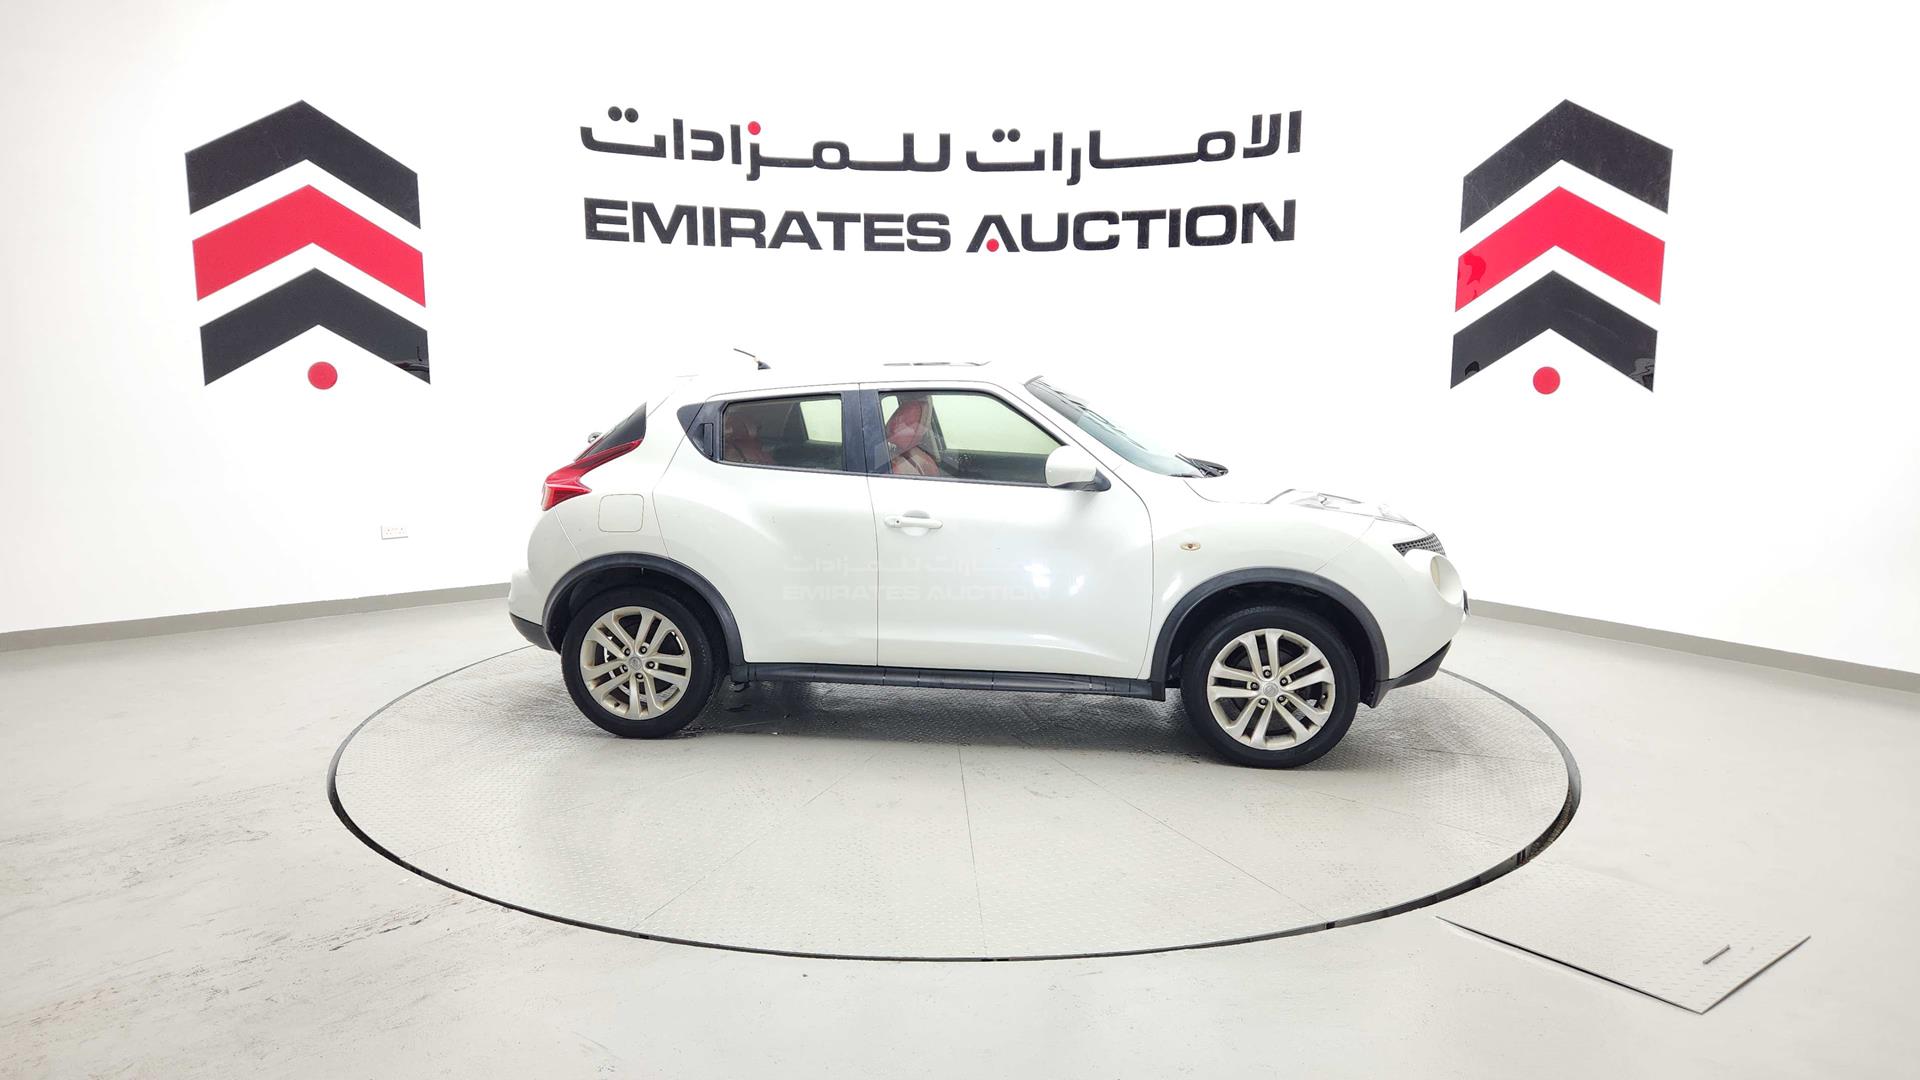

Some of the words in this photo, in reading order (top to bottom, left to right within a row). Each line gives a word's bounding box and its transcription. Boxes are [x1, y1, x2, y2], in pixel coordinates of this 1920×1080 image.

[580, 106, 951, 182] للمزادات
[965, 110, 1303, 186] الامارات
[583, 197, 951, 252] EMIRATES
[966, 199, 1297, 253] AUCTION
